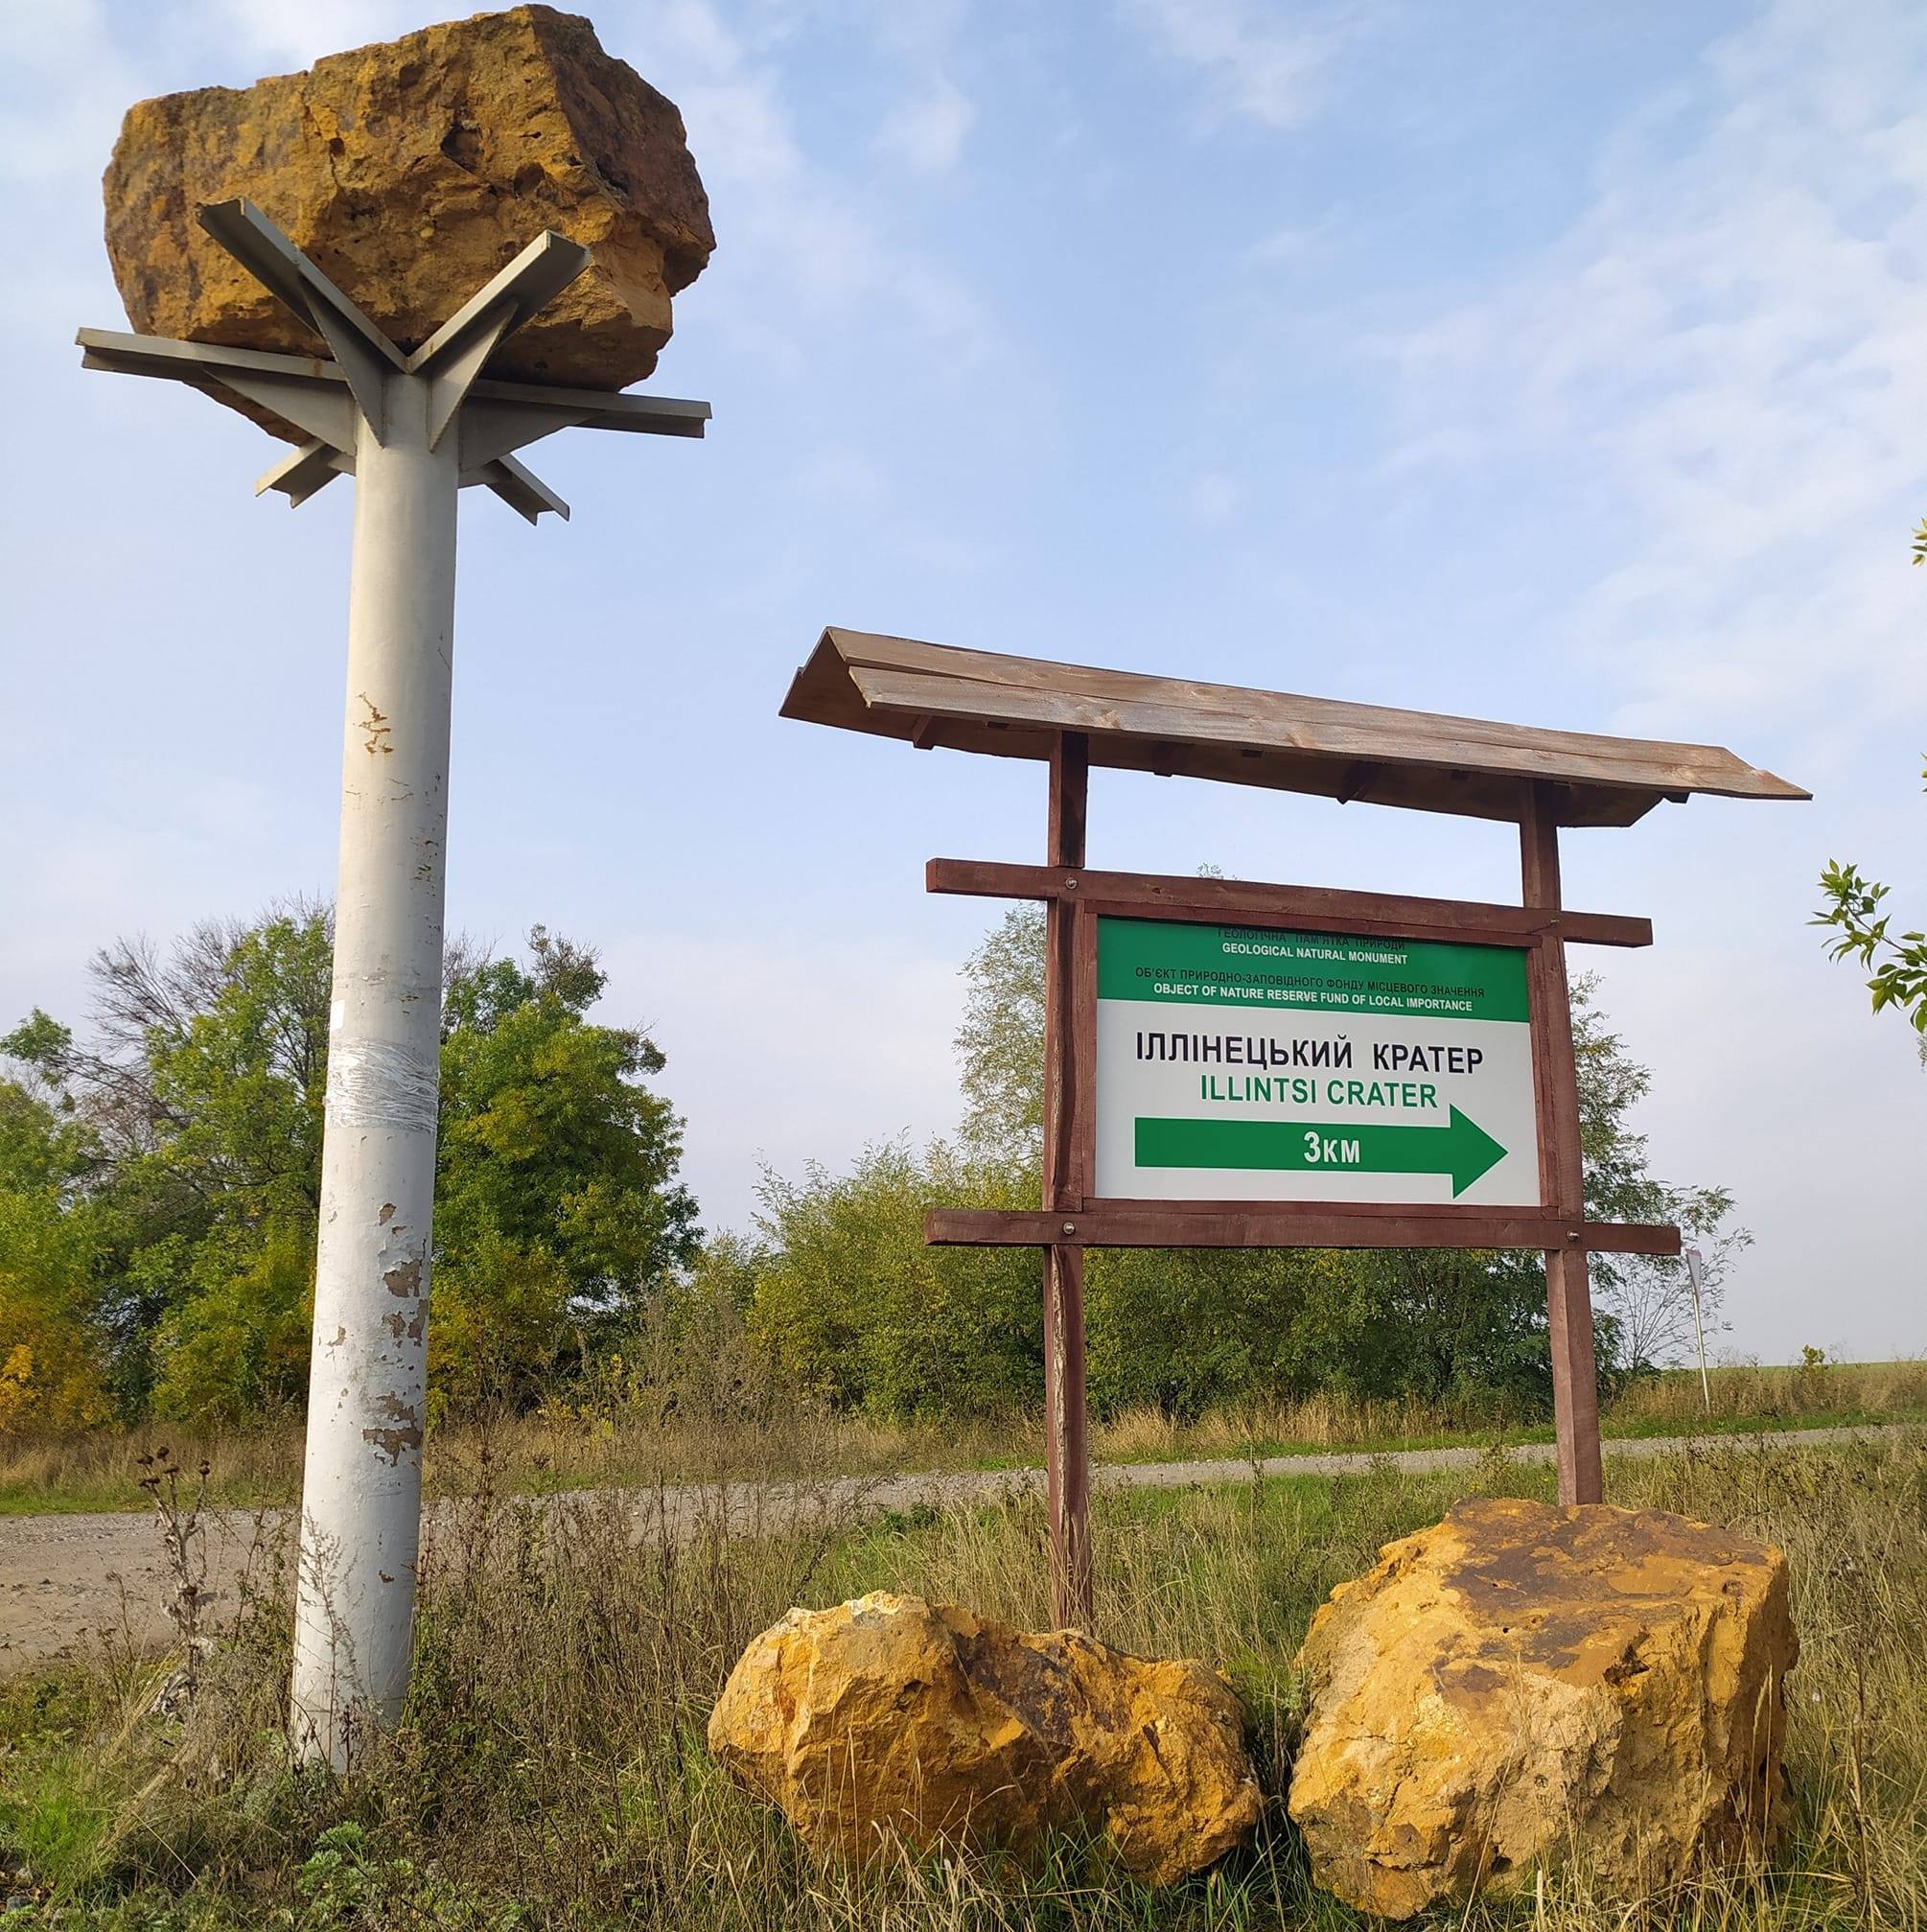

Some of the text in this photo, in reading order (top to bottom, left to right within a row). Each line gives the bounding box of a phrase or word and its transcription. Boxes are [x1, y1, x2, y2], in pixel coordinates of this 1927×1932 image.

[1222, 943, 1407, 965] GEOLOGICAL NATURAL MONUMENT
[1153, 983, 1473, 1012] OBJECT OF NATURE RESERVE FUND OF LOCAL IMPORTANCE
[1180, 969, 1323, 989] ПРИРОДНО-ЗАПОВІДНОГО
[1326, 978, 1363, 991] ФОНДУ
[1367, 981, 1428, 995] МІСЦЕВОГО
[1430, 985, 1485, 997] ЗНАЧЕННЯ
[1136, 1031, 1483, 1074] ІЛЛІНЕЦЬКИЙ КРАТЕР
[1200, 1075, 1438, 1108] ILLINTSI CRATER
